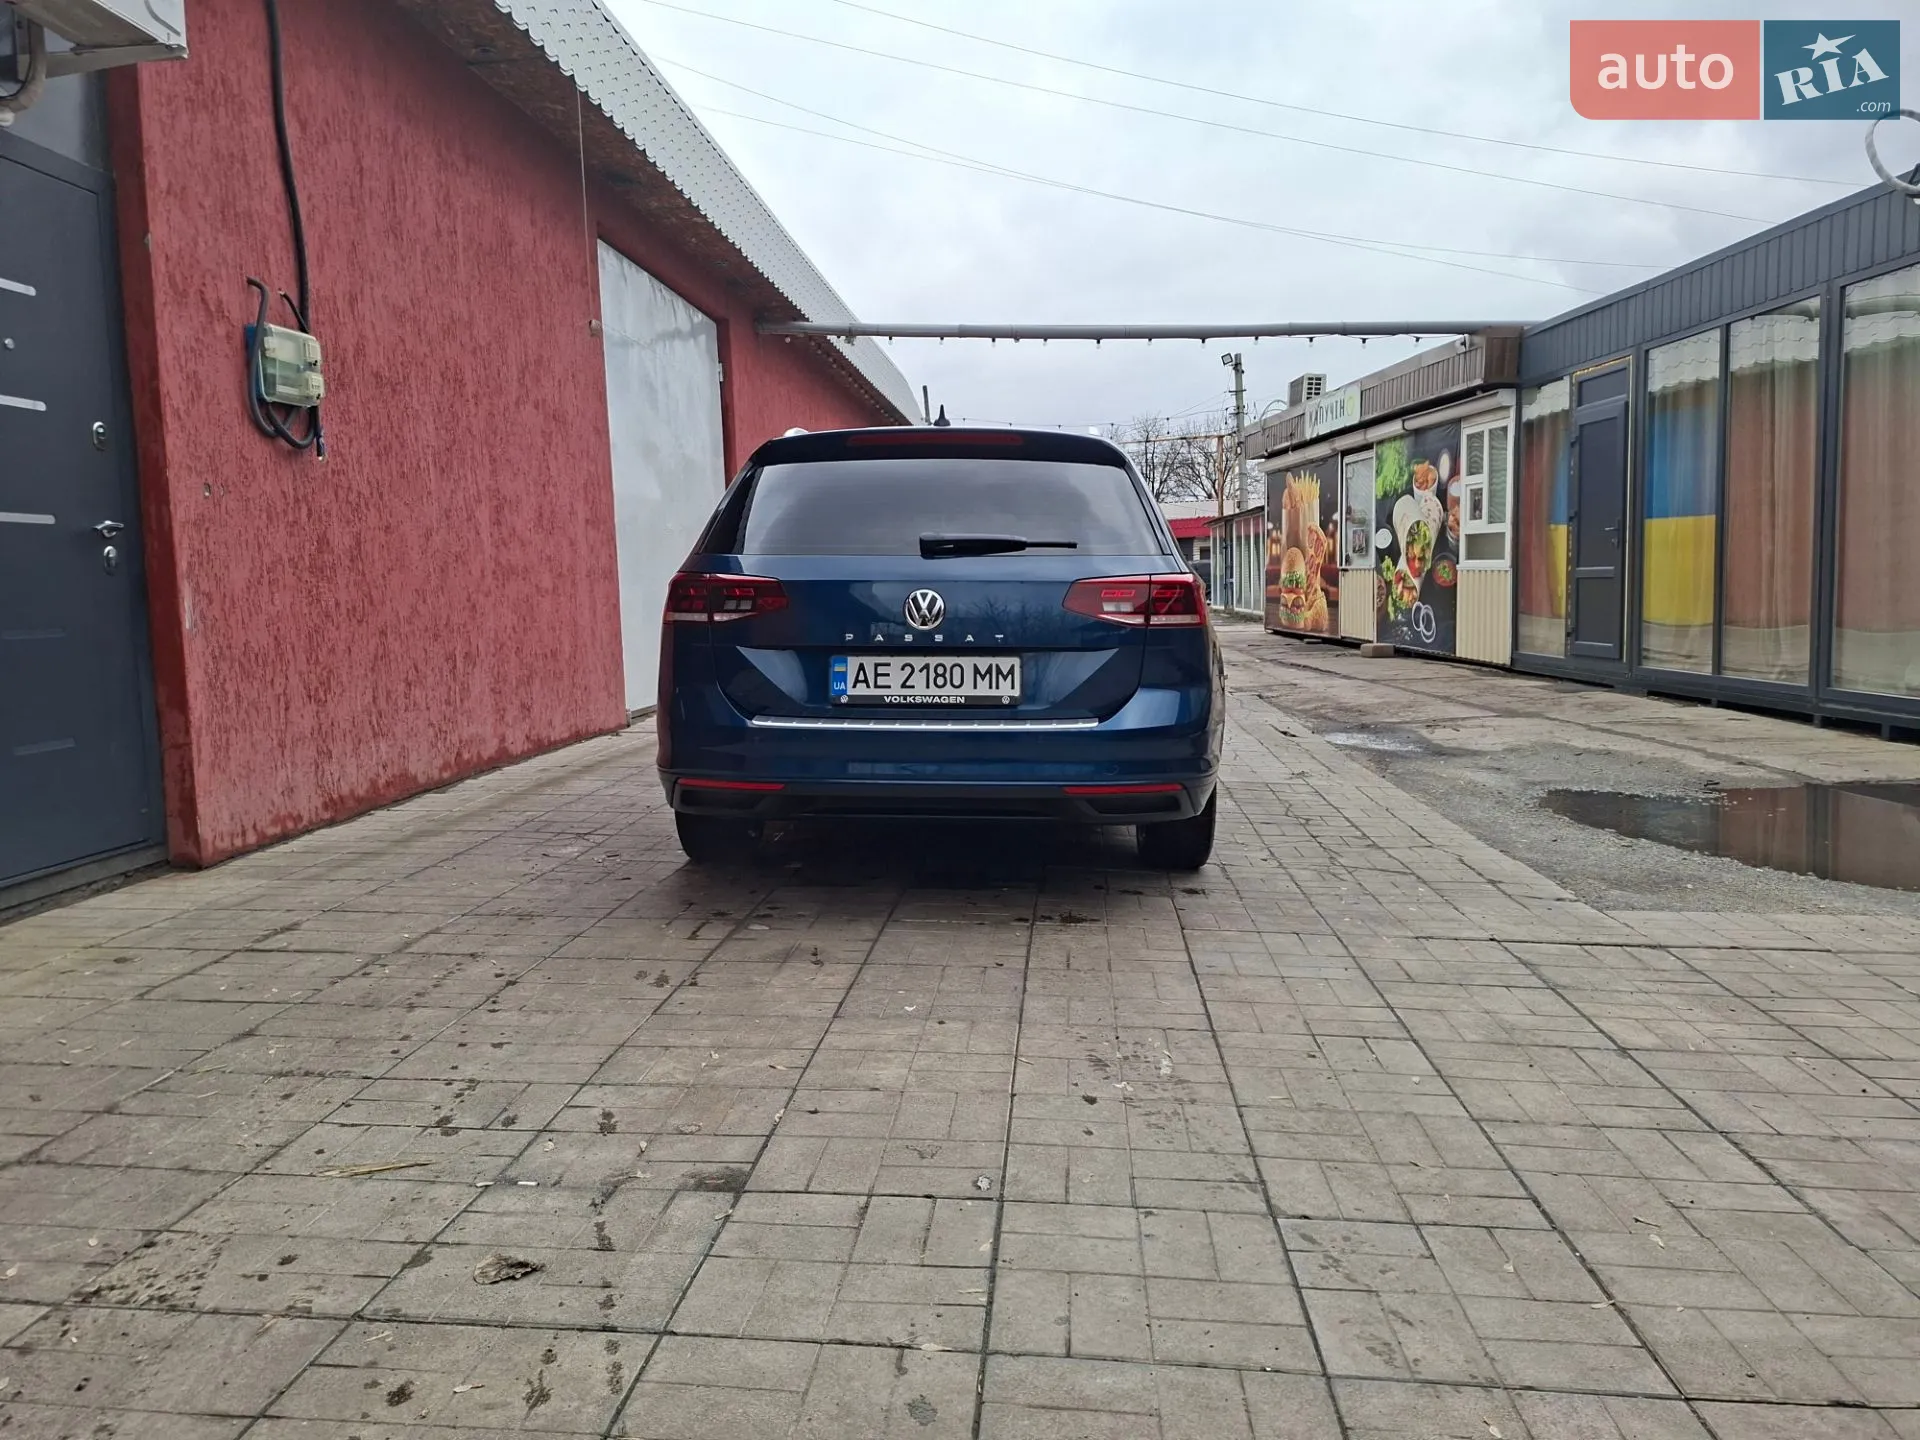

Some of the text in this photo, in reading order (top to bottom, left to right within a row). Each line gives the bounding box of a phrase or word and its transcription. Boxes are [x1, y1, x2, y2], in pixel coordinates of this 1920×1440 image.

[845, 633, 1004, 643] PASSAT
[852, 662, 1016, 690] AE 2180 MM
[833, 681, 847, 690] UA
[884, 695, 965, 704] VOLKSWAGEN
